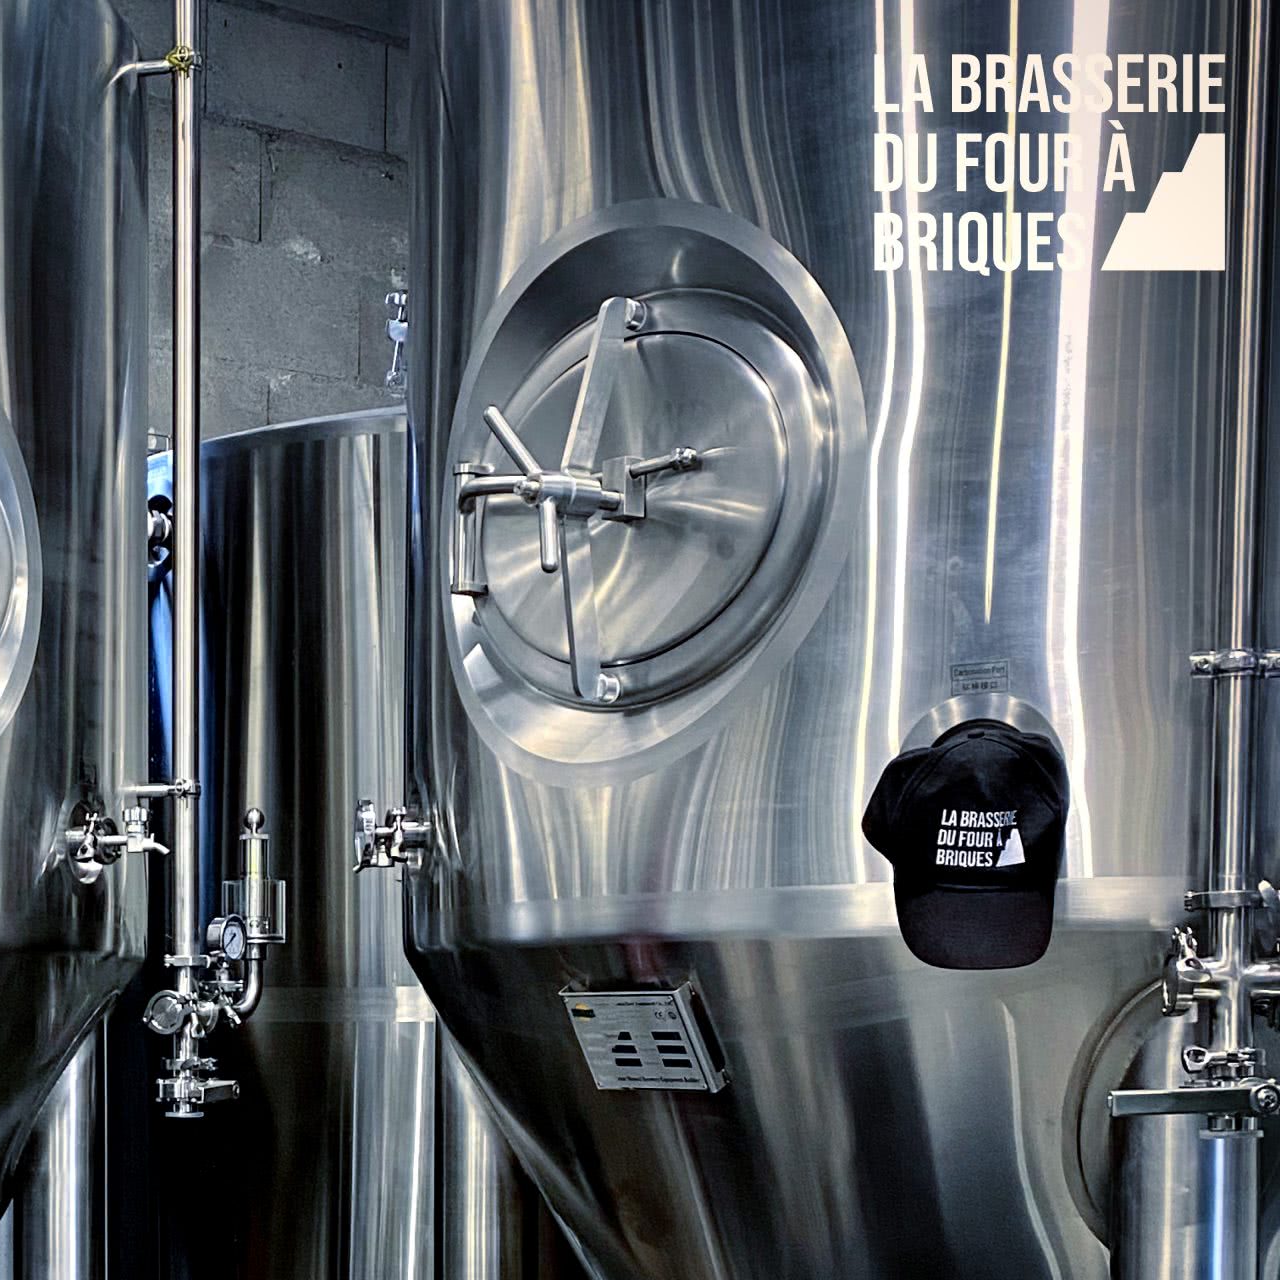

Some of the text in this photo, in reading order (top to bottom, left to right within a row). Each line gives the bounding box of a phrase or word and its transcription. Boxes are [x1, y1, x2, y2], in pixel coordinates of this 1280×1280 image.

[941, 809, 957, 826] LA
[937, 828, 957, 847] DU
[958, 830, 993, 848] FOUR
[935, 848, 993, 867] BRIQUES
